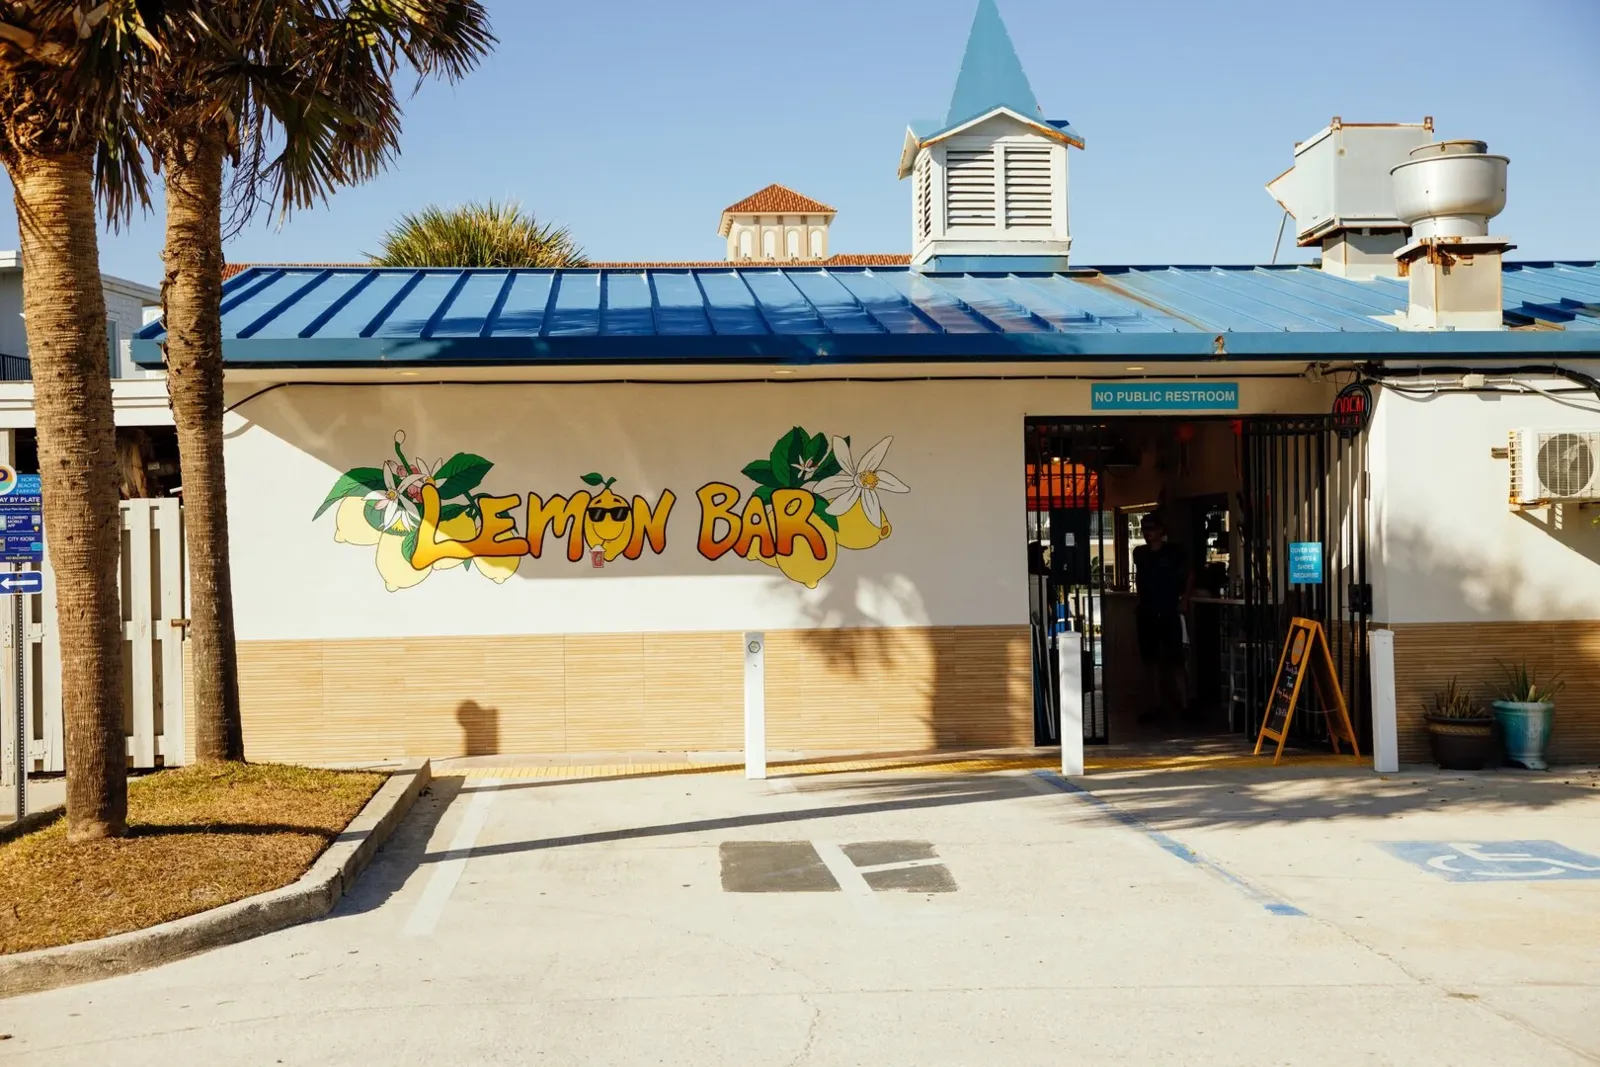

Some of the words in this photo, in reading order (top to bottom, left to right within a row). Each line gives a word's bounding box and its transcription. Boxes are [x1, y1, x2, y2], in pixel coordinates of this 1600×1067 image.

[1095, 391, 1113, 402] NO
[1117, 391, 1162, 402] PUBLIC
[1165, 390, 1235, 401] RESTROOM
[411, 482, 677, 571] LEMON
[696, 481, 828, 561] BAR
